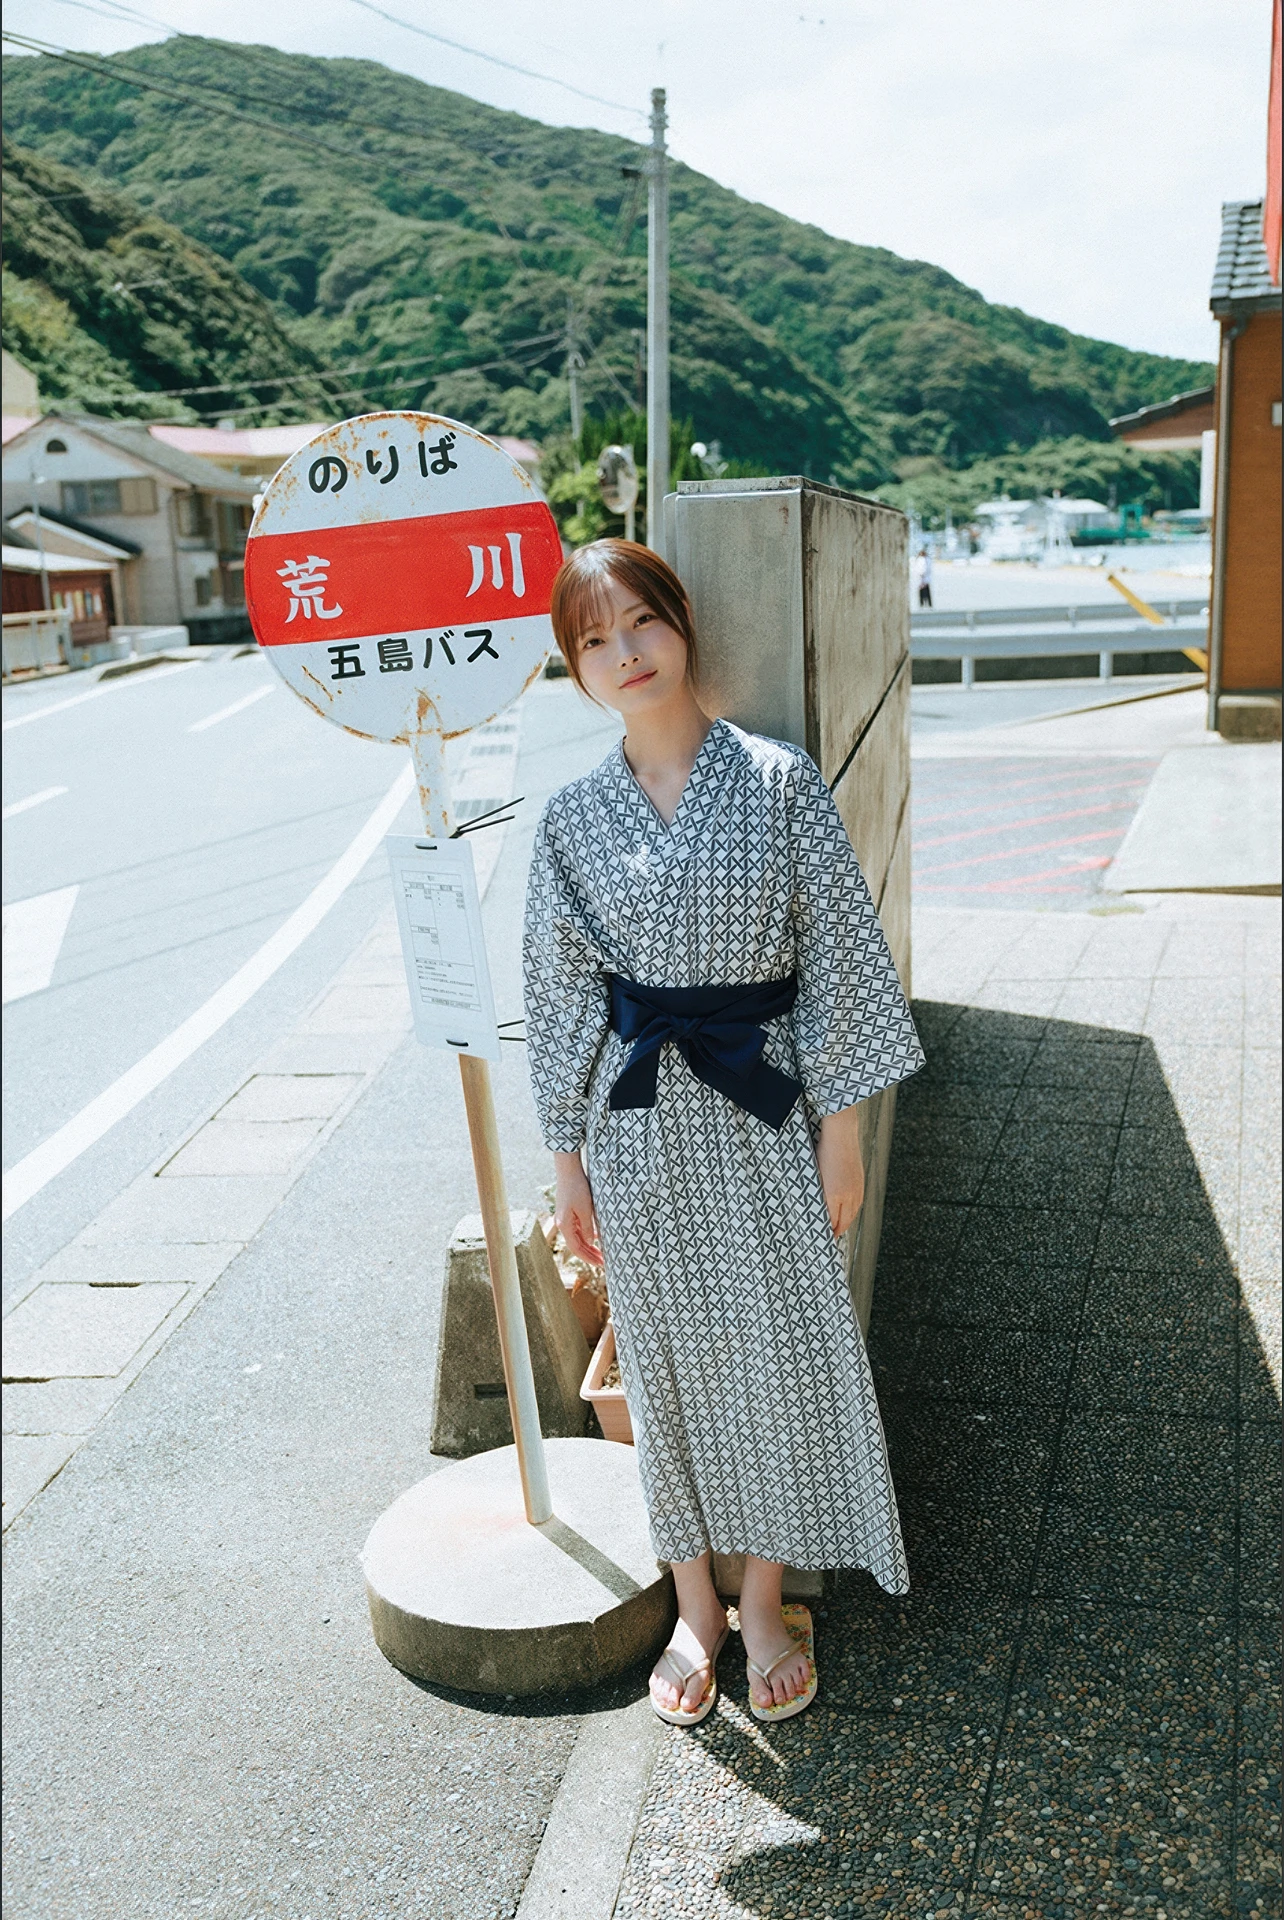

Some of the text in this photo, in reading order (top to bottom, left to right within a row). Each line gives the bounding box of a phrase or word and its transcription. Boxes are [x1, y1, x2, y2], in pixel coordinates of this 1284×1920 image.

[308, 432, 457, 493] のりば
[275, 532, 526, 623] 荒川
[327, 628, 499, 680] 五島バス
